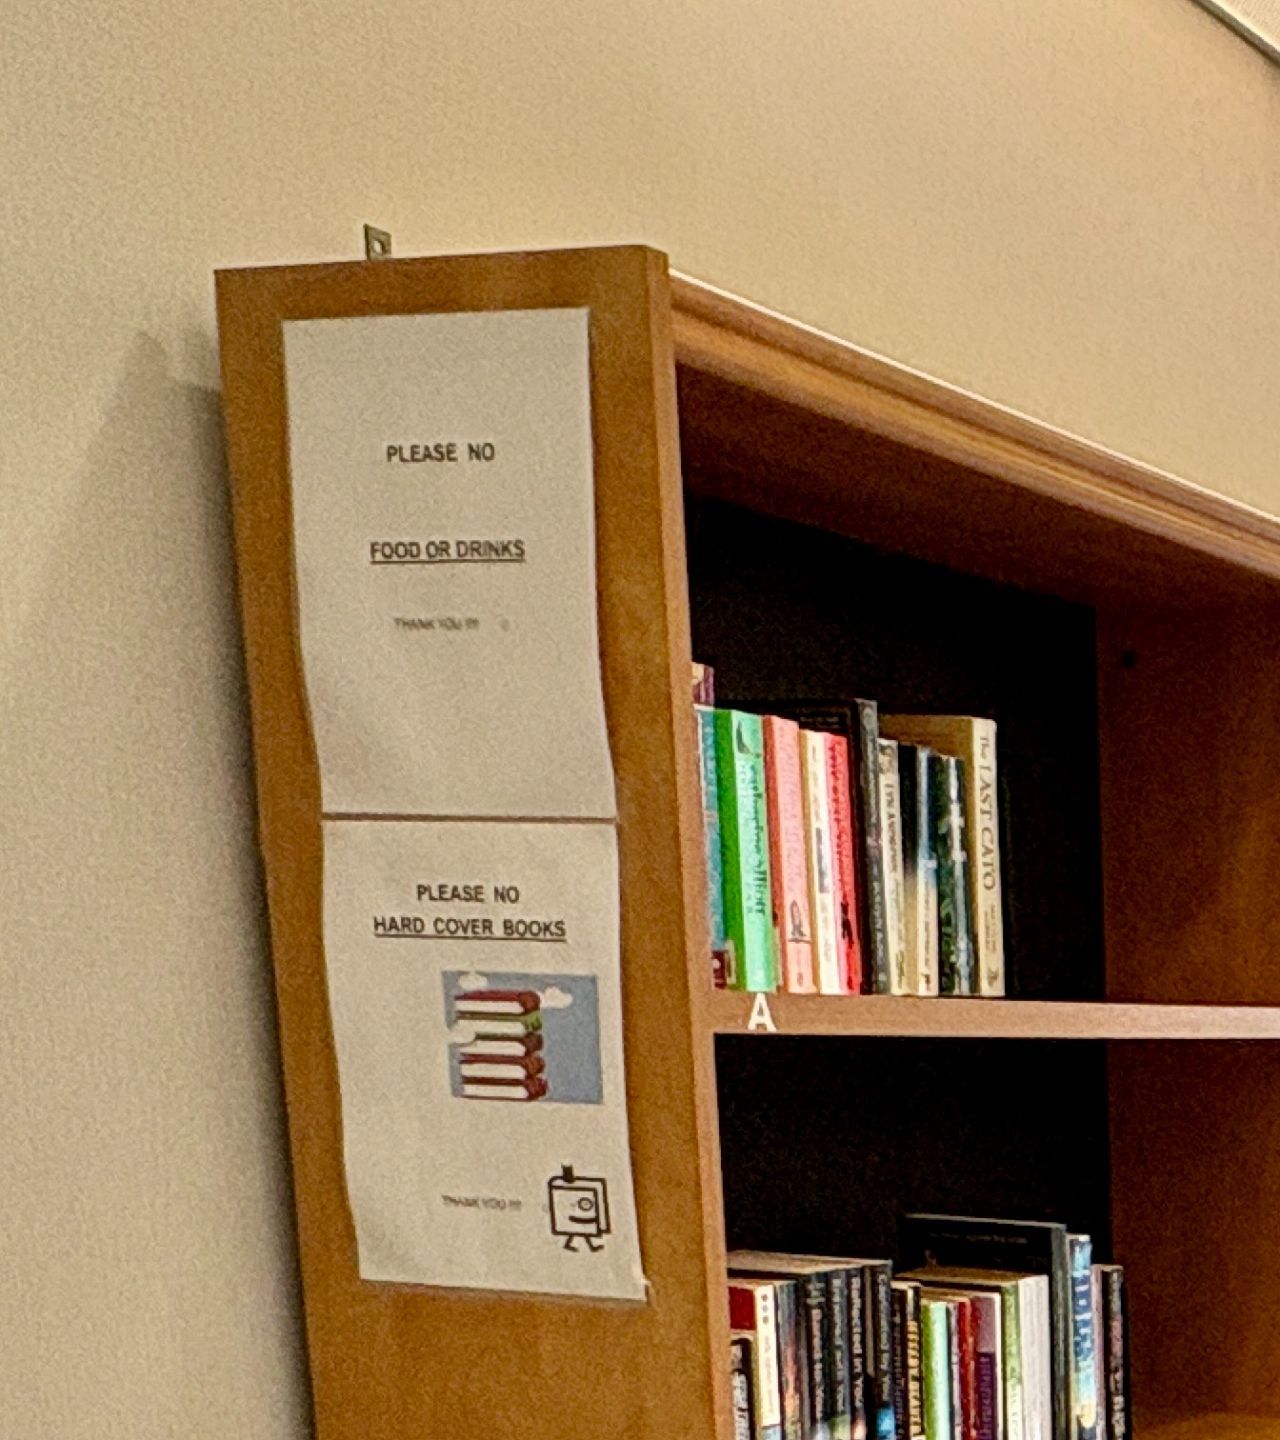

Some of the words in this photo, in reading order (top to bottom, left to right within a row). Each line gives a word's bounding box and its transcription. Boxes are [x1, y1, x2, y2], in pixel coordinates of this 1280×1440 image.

[387, 443, 457, 464] PLEASE
[468, 442, 495, 462] NO
[370, 541, 421, 561] FOOD
[425, 541, 451, 559] OR
[455, 540, 525, 559] DRINKS
[979, 827, 998, 891] CATO
[417, 885, 485, 902] PLEASE
[494, 886, 520, 904] NO
[374, 916, 425, 934] HARD
[433, 918, 494, 936] COVER
[503, 920, 567, 938] BOOKS
[746, 992, 777, 1032] A
